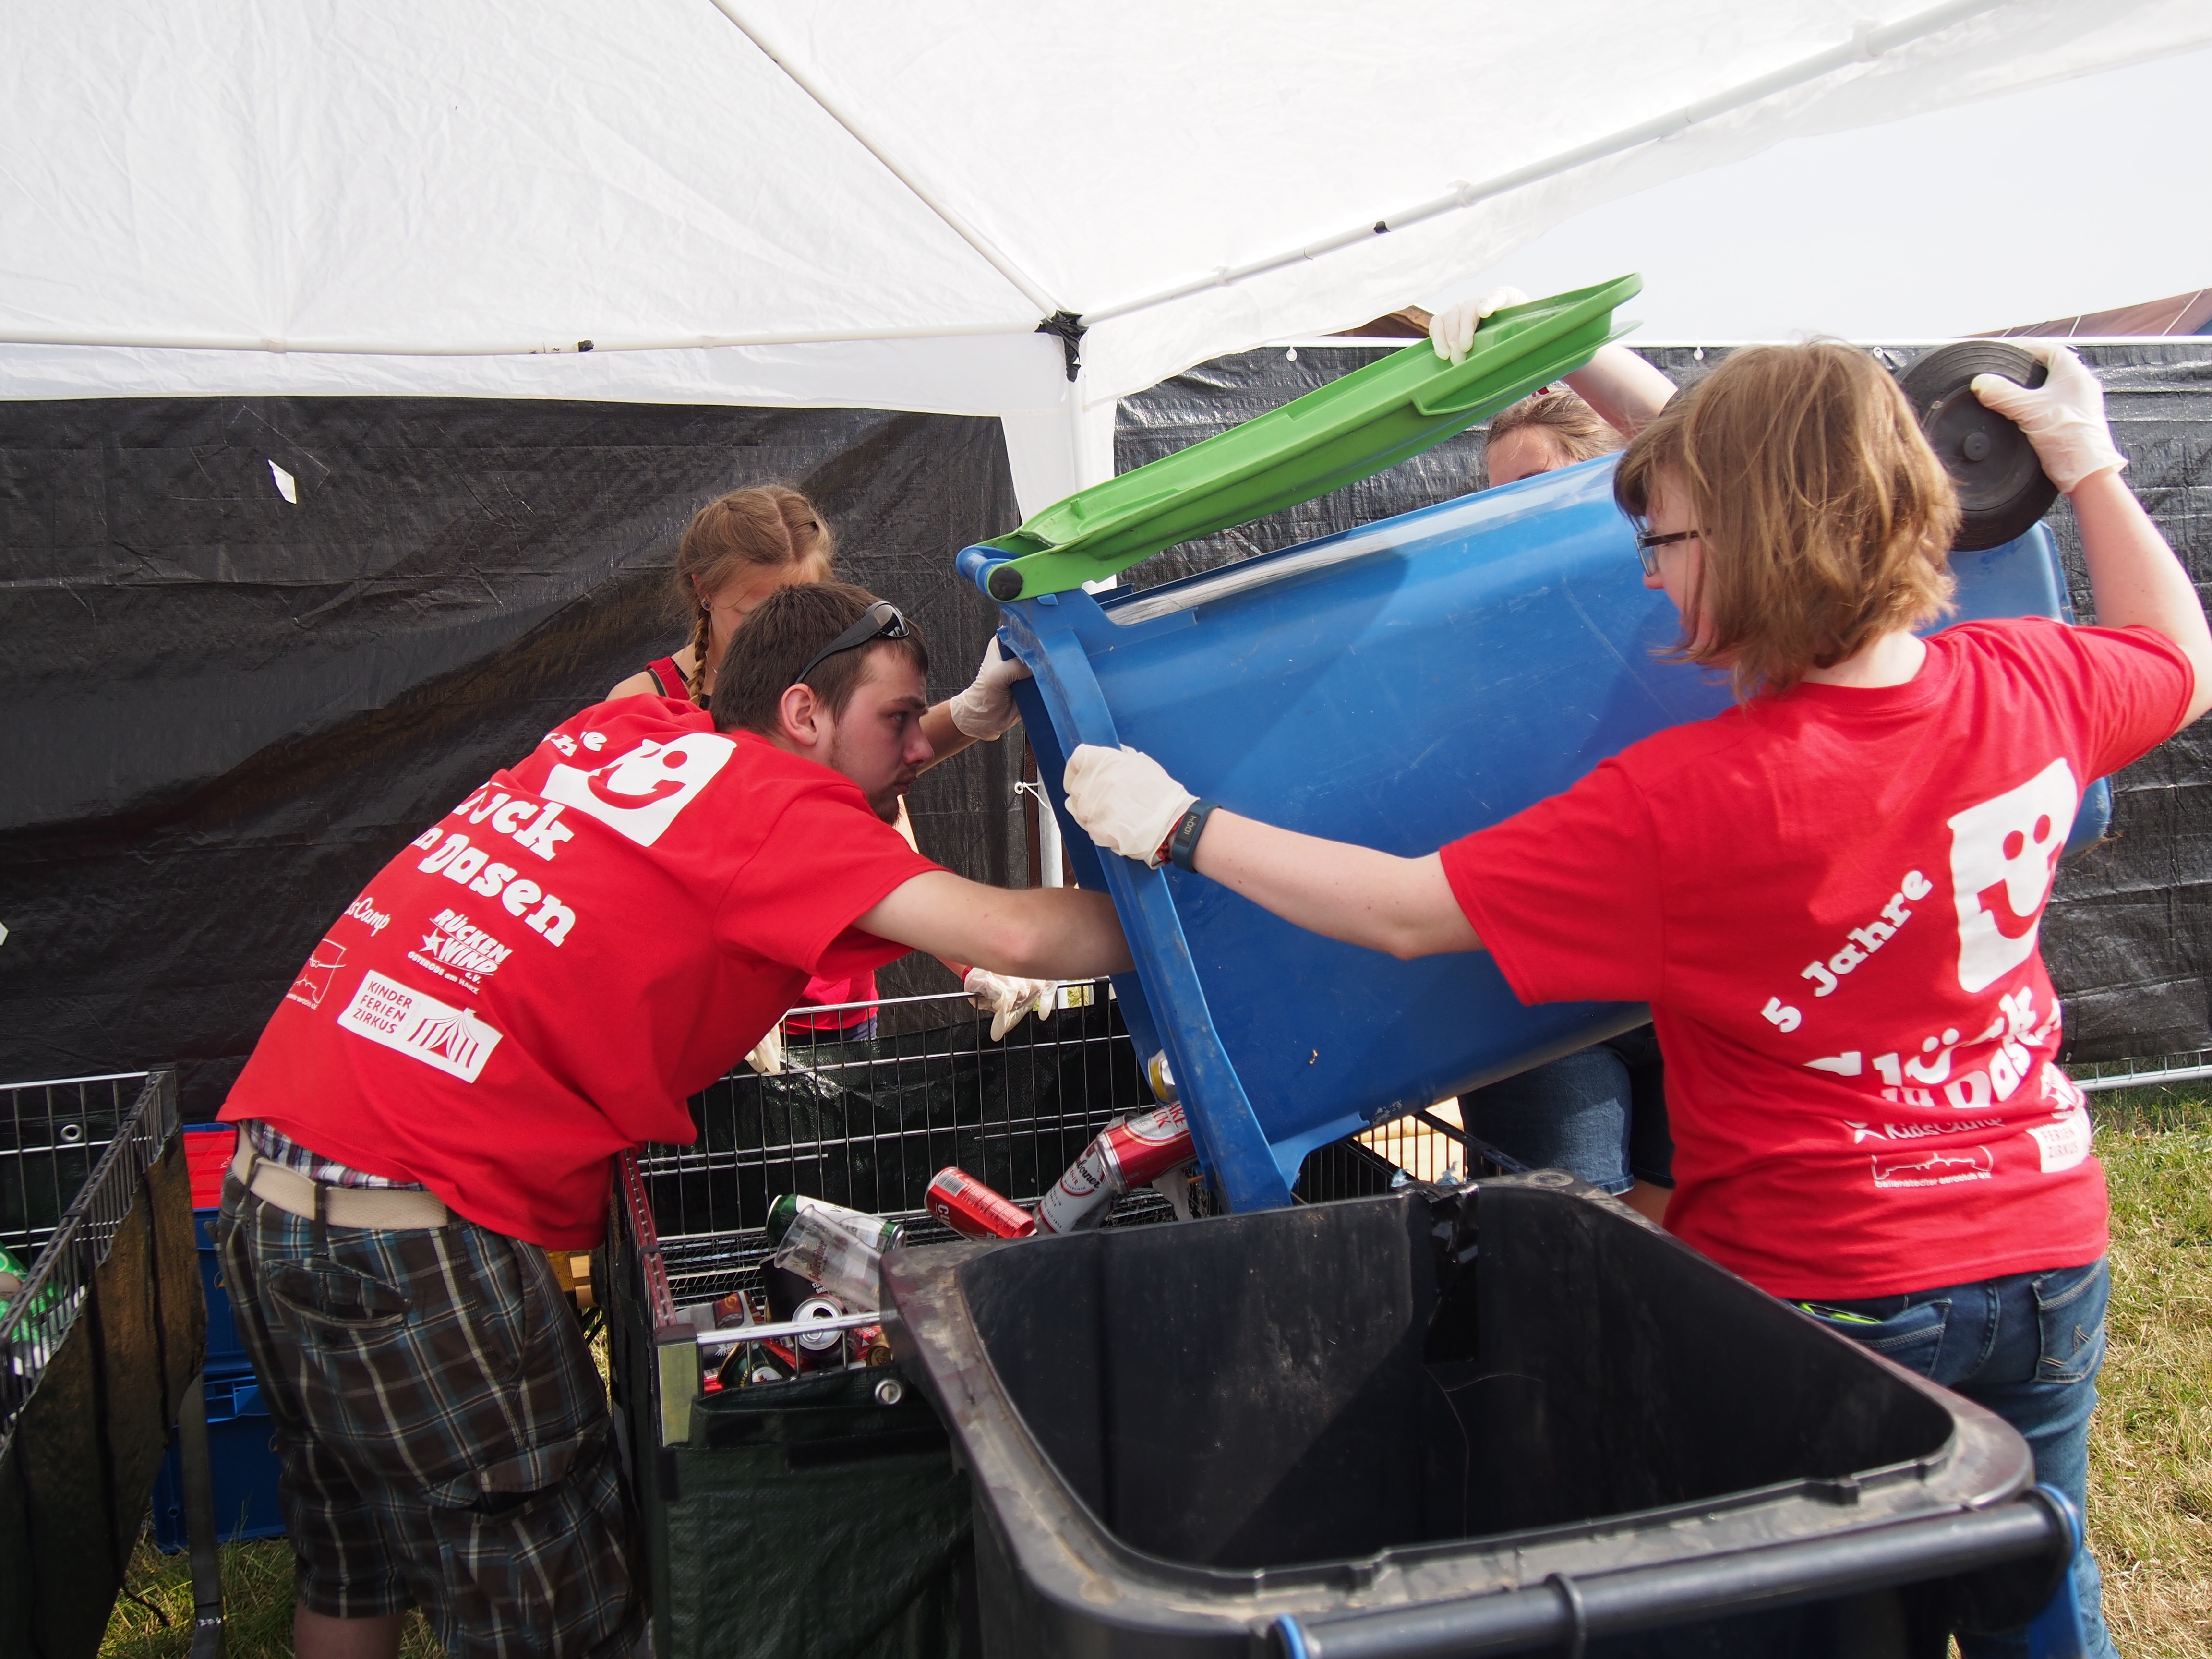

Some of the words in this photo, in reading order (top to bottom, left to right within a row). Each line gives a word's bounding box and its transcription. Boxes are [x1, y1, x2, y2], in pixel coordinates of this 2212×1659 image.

[1183, 815, 1197, 835] 1004
[417, 834, 576, 947] Dosen
[433, 908, 513, 963] RÜCKEN
[1760, 997, 1802, 1033] 5
[1800, 870, 1933, 997] Jahre
[438, 937, 498, 973] WIND
[360, 994, 406, 1022] FERIEN
[367, 980, 413, 1009] KINDER
[352, 1008, 397, 1034] ZIRKUS
